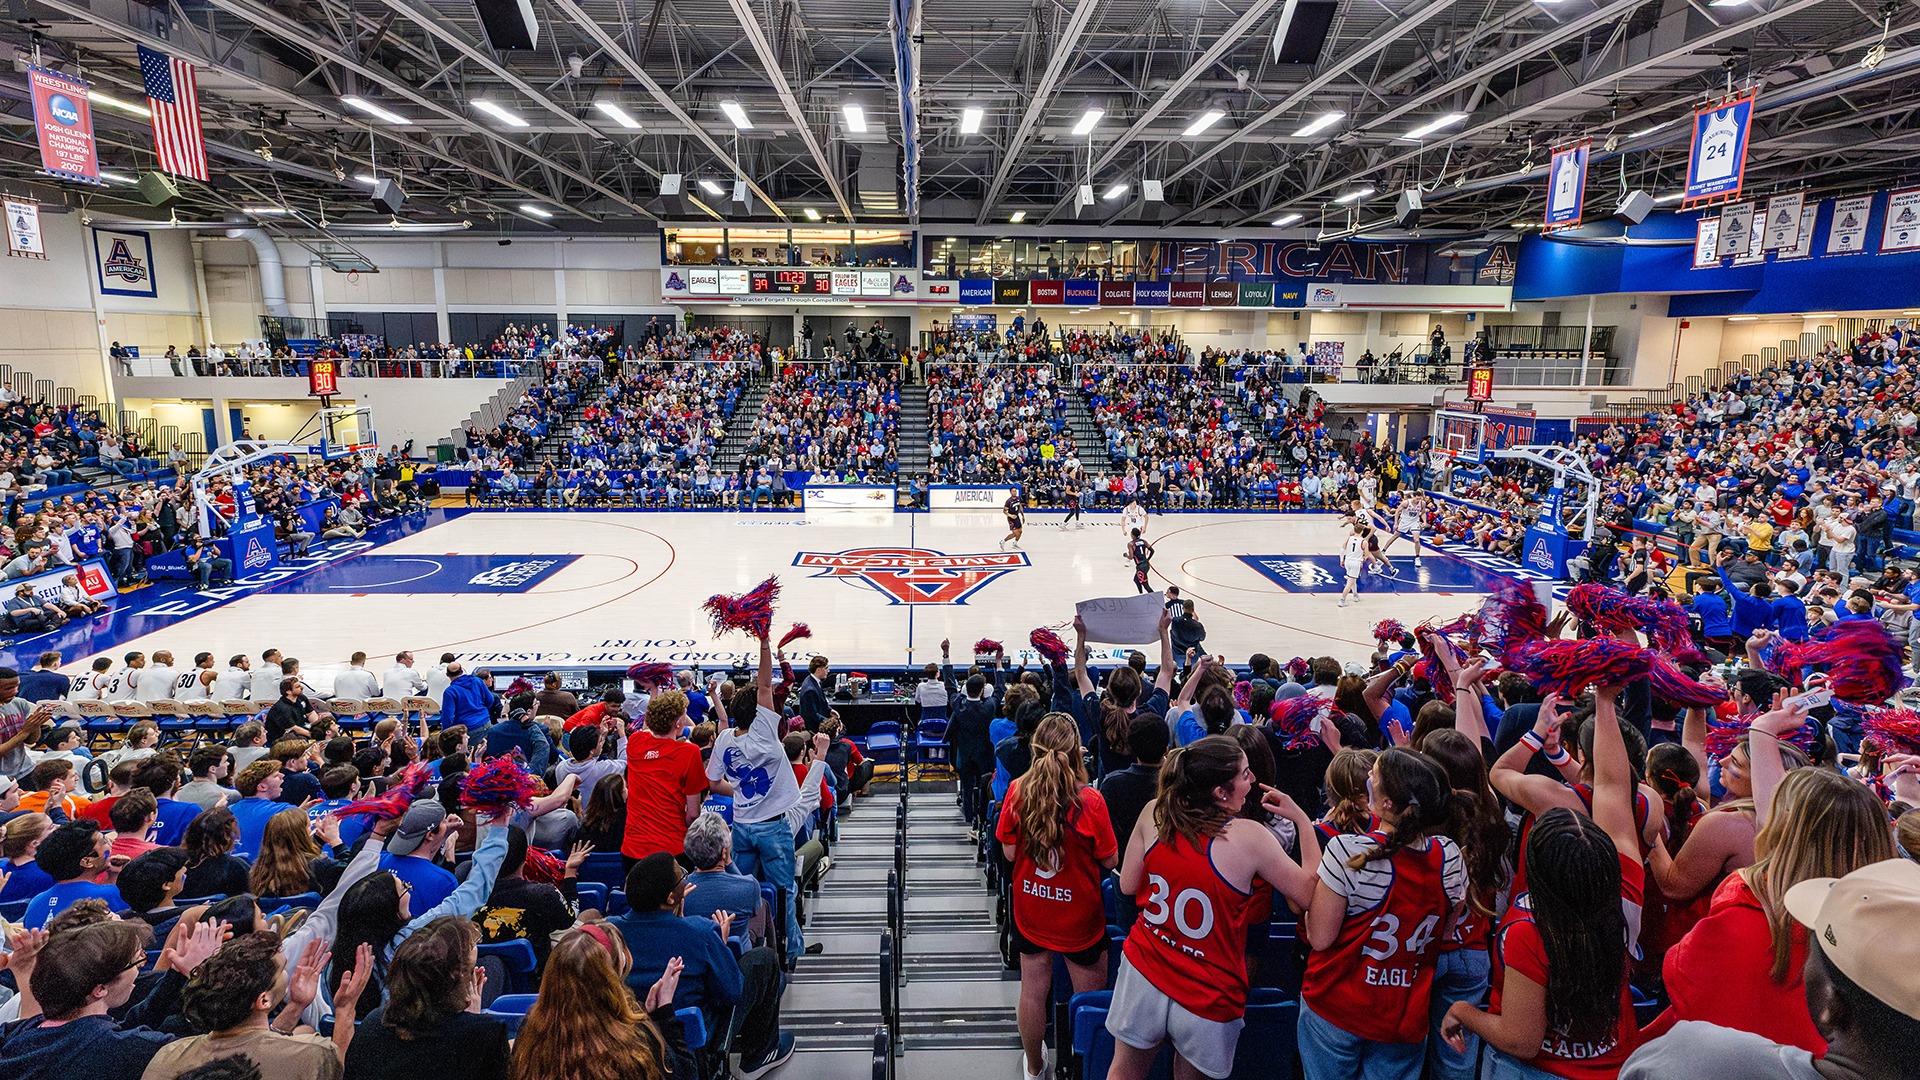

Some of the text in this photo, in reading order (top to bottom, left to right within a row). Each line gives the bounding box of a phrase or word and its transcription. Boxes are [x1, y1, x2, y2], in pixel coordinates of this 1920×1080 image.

[33, 73, 86, 95] WRESTLING
[52, 107, 79, 122] NCAA
[44, 123, 91, 140] JOSH GLENN
[49, 134, 88, 148] NATIONAL
[48, 141, 90, 155] CHAMPION
[1706, 142, 1727, 161] 24
[55, 150, 86, 163] 197 LBS.
[61, 162, 84, 172] 2007
[1706, 177, 1738, 187] WASHINGTON
[1891, 199, 1920, 207] VOLLEYBA
[1896, 193, 1920, 201] WOMEN'
[1771, 201, 1801, 209] VOLLEYBALL
[1836, 205, 1869, 213] VOLLEYBALL
[1070, 240, 1408, 282] AMERICAN
[108, 265, 144, 276] AMERICAN
[691, 277, 717, 285] EAGLES
[778, 271, 805, 283] 17:23
[835, 279, 858, 287] EAGLES
[754, 279, 768, 290] 39
[816, 280, 829, 291] 30
[793, 285, 800, 293] 2
[961, 289, 991, 297] AMERICAN
[1002, 289, 1020, 297] ARMY
[1037, 288, 1057, 296] BOSTON
[1066, 289, 1097, 297] BUCKNELL
[1105, 290, 1131, 298] COLGATE
[1151, 290, 1169, 298] CROSS
[1245, 290, 1267, 298] LOYOLA
[315, 363, 332, 373] 17:23
[315, 373, 331, 391] 30
[1474, 380, 1487, 396] 30
[1504, 409, 1532, 417] COMPETITION
[1446, 419, 1532, 450] AMRICAN
[1453, 474, 1466, 482] SAY
[955, 490, 994, 503] AMERICAN
[246, 554, 271, 566] AMERICAN
[808, 555, 1012, 566] AMERICAN
[85, 576, 100, 587] AU
[133, 541, 374, 616] EAGLES
[39, 584, 68, 599] SELTZ
[594, 638, 697, 648] COURT
[578, 651, 656, 663] "POP"
[71, 677, 89, 692] 15
[109, 679, 119, 694] 3
[178, 673, 197, 688] 30
[1023, 879, 1072, 902] EAGLES
[1143, 873, 1214, 940] 30
[1361, 913, 1440, 961] 34
